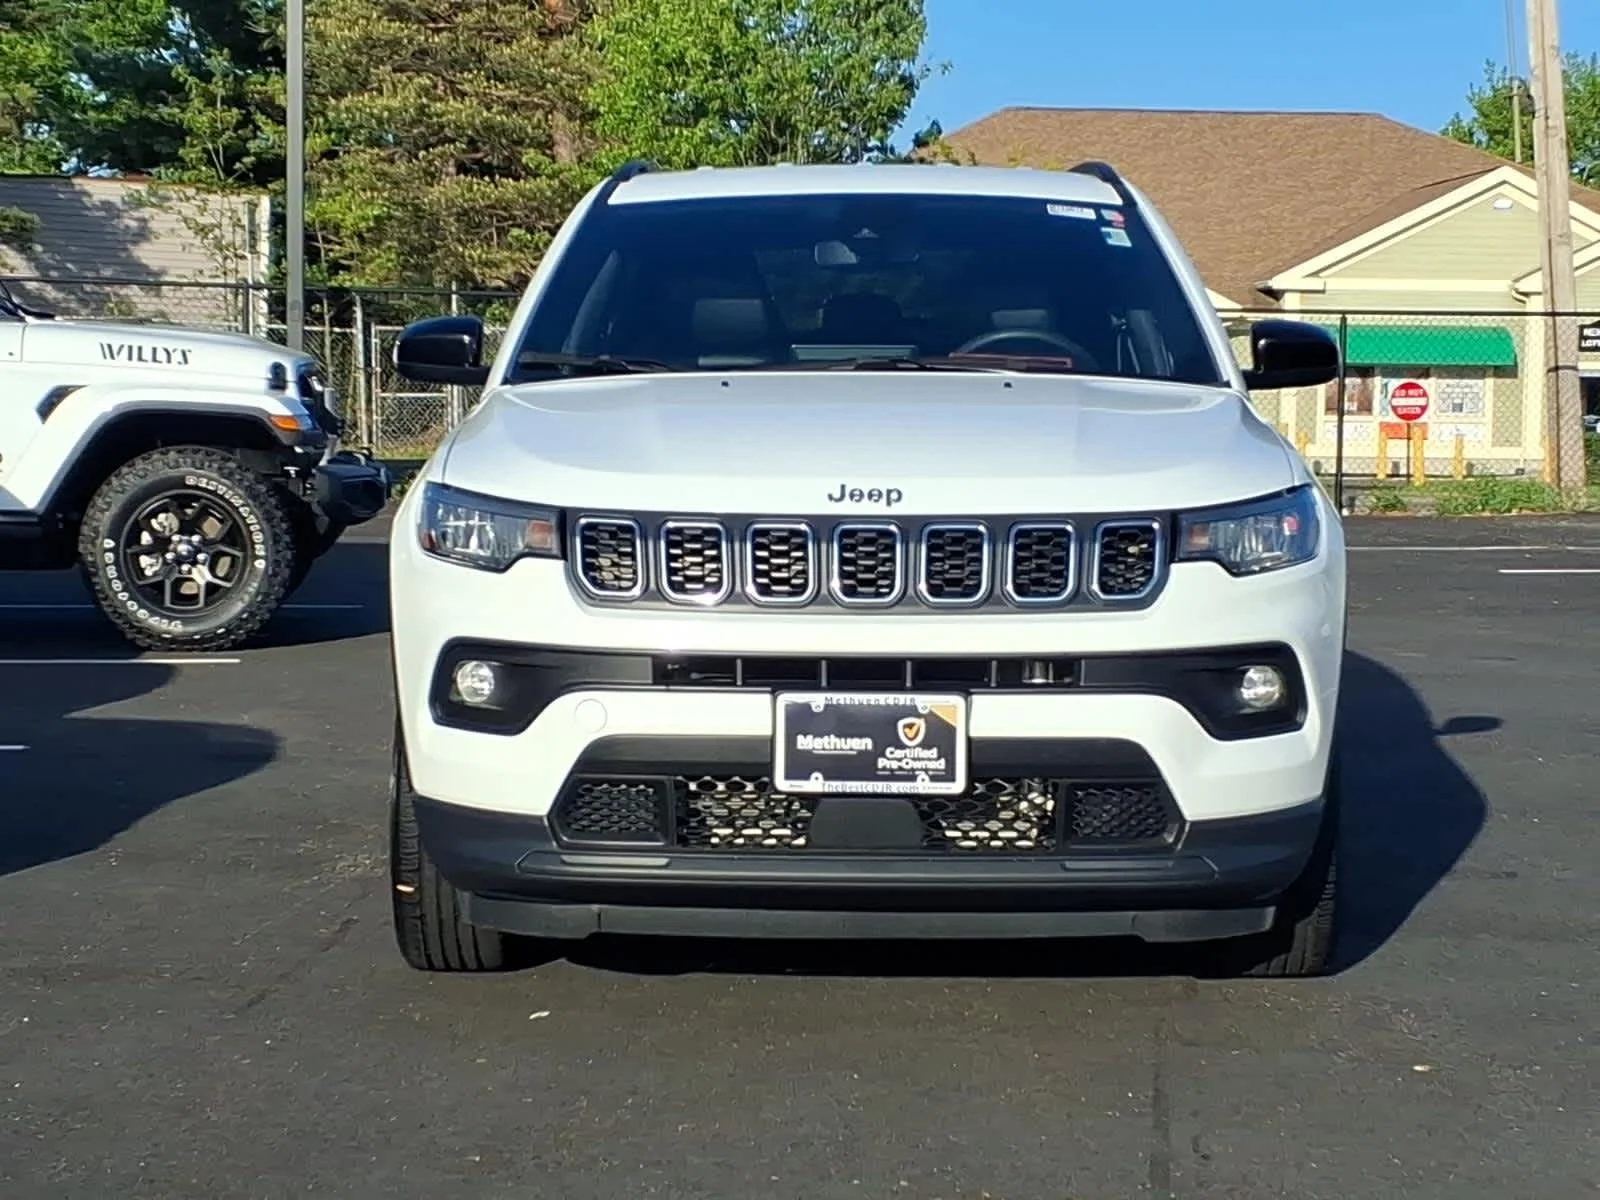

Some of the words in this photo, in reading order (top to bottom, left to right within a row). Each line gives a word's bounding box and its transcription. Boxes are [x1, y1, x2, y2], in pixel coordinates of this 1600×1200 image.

[99, 342, 192, 365] WILLYS
[827, 483, 903, 508] Jeep
[796, 734, 873, 750] Methuen
[885, 747, 938, 758] Certified
[877, 758, 946, 769] Pre-Owned
[821, 783, 919, 793] TheBestCDJR.com
